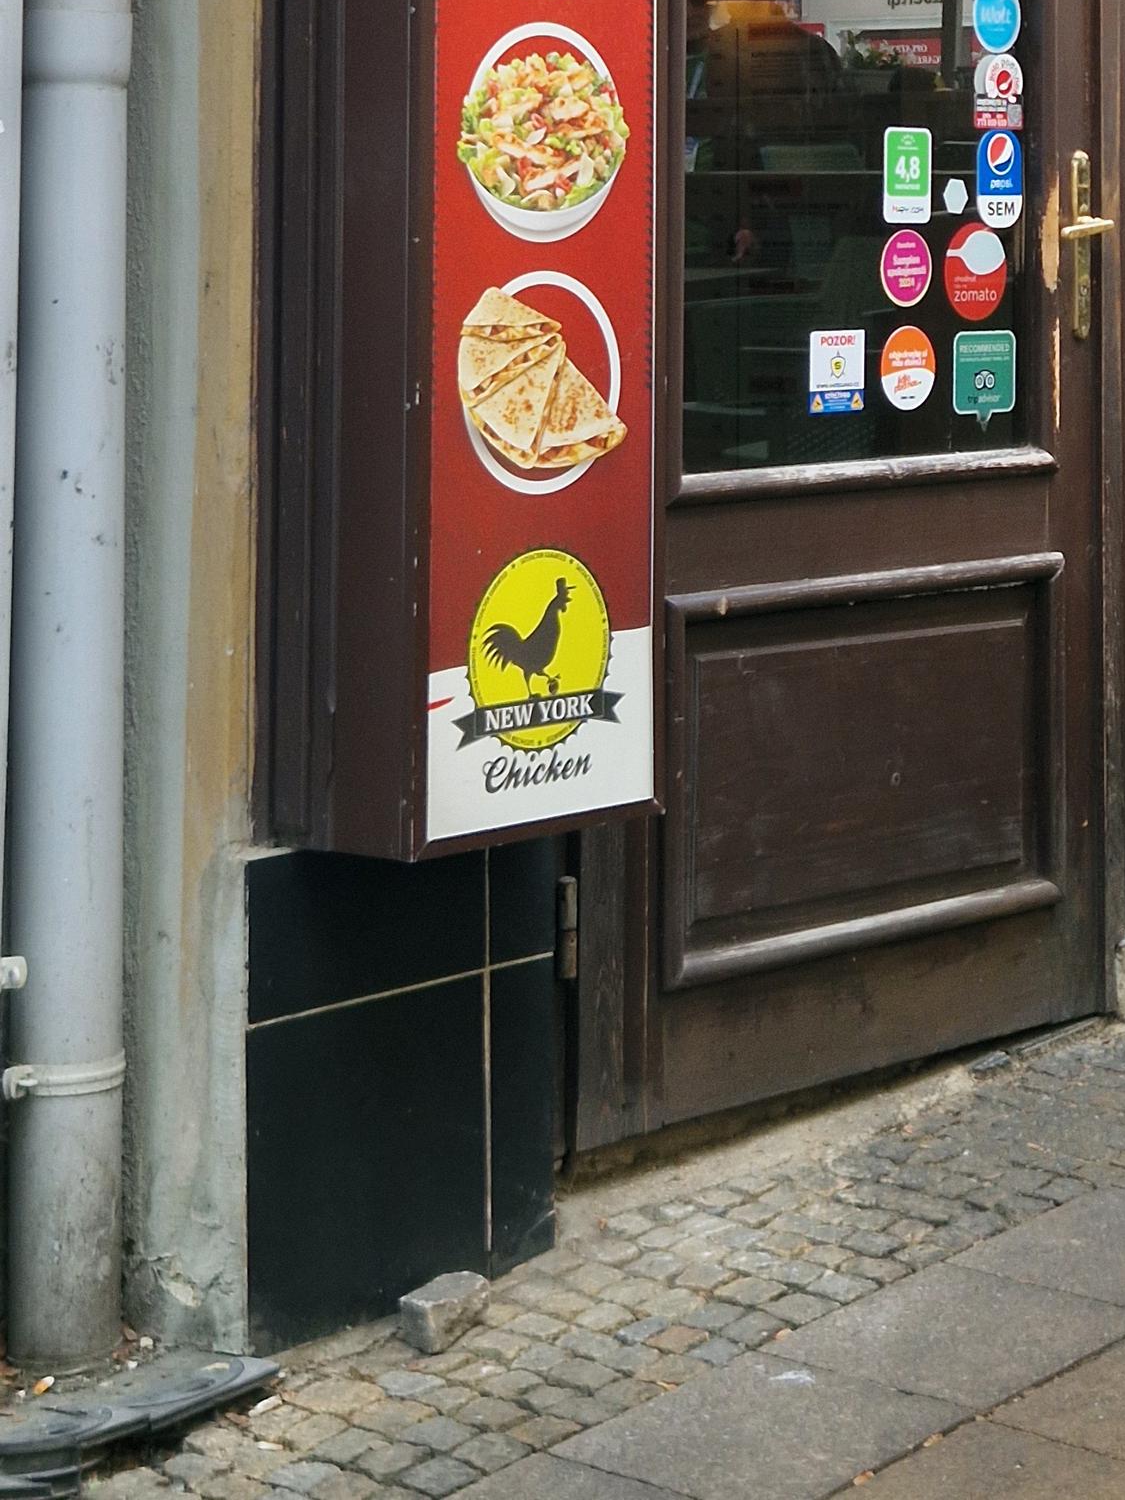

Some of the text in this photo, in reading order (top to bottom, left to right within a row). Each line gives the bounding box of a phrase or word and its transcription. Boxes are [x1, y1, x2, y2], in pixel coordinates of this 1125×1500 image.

[895, 155, 921, 183] 4,8
[987, 201, 1015, 216] SEM
[953, 288, 998, 302] zomato
[820, 335, 856, 346] POZOR!
[484, 693, 595, 732] NEW YORK
[482, 750, 593, 794] Chicken
